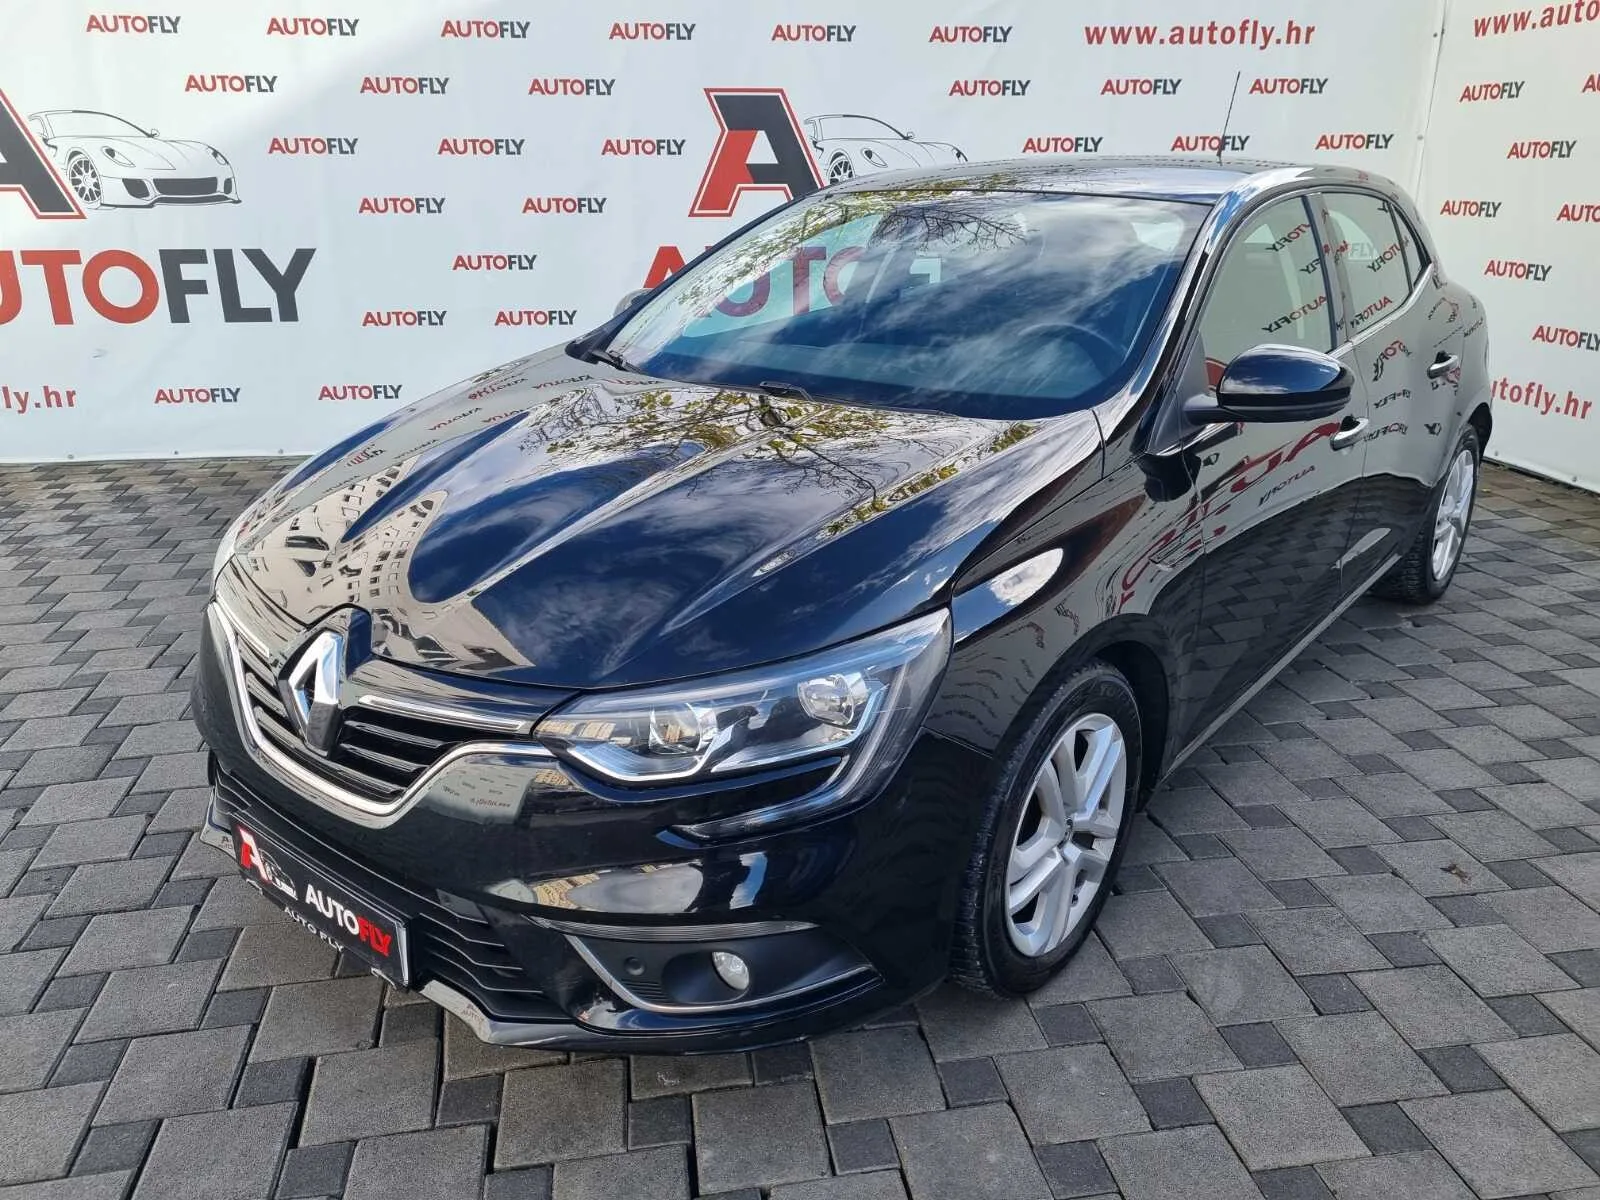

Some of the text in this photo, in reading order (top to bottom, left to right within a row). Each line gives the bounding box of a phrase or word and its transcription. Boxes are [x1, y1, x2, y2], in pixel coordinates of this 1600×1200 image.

[87, 15, 180, 33] AUTOFLY
[267, 18, 359, 36] AUTOFLY
[441, 21, 530, 38] AUTOFLY
[609, 23, 696, 40] AUTOFLY
[772, 25, 856, 42] AUTOFLY
[929, 26, 1012, 42] AUTOFLY
[1085, 19, 1315, 50] www.autofly.hr
[185, 75, 277, 92] AUTOFLY
[360, 77, 449, 94] AUTOFLY
[529, 79, 615, 95] AUTOFLY
[949, 80, 1030, 96] AUTOFLY
[1101, 79, 1182, 95] AUTOFLY
[1249, 78, 1328, 94] AUTOFLY
[1460, 81, 1525, 102] AUTOFLY
[268, 138, 358, 154] AUTOFLY
[438, 139, 525, 155] AUTOFLY
[602, 139, 685, 155] AUTOFLY
[1023, 137, 1103, 153] AUTOFLY
[1171, 136, 1250, 151] AUTOFLY
[1315, 134, 1394, 149] AUTOFLY
[1507, 141, 1576, 159] AUTOFLY
[359, 198, 445, 213] AUTOFLY
[523, 198, 607, 213] AUTOFLY
[1440, 200, 1501, 217] AUTOFLY
[453, 255, 537, 270] AUTOFLY
[1484, 260, 1552, 281] AUTOFLY
[363, 311, 447, 326] AUTOFLY
[495, 310, 577, 326] AUTOFLY
[155, 388, 240, 403] AUTOFLY
[319, 385, 402, 400] AUTOFLY
[305, 883, 392, 957] AUTOFLY
[284, 906, 344, 952] AUTO FLY
